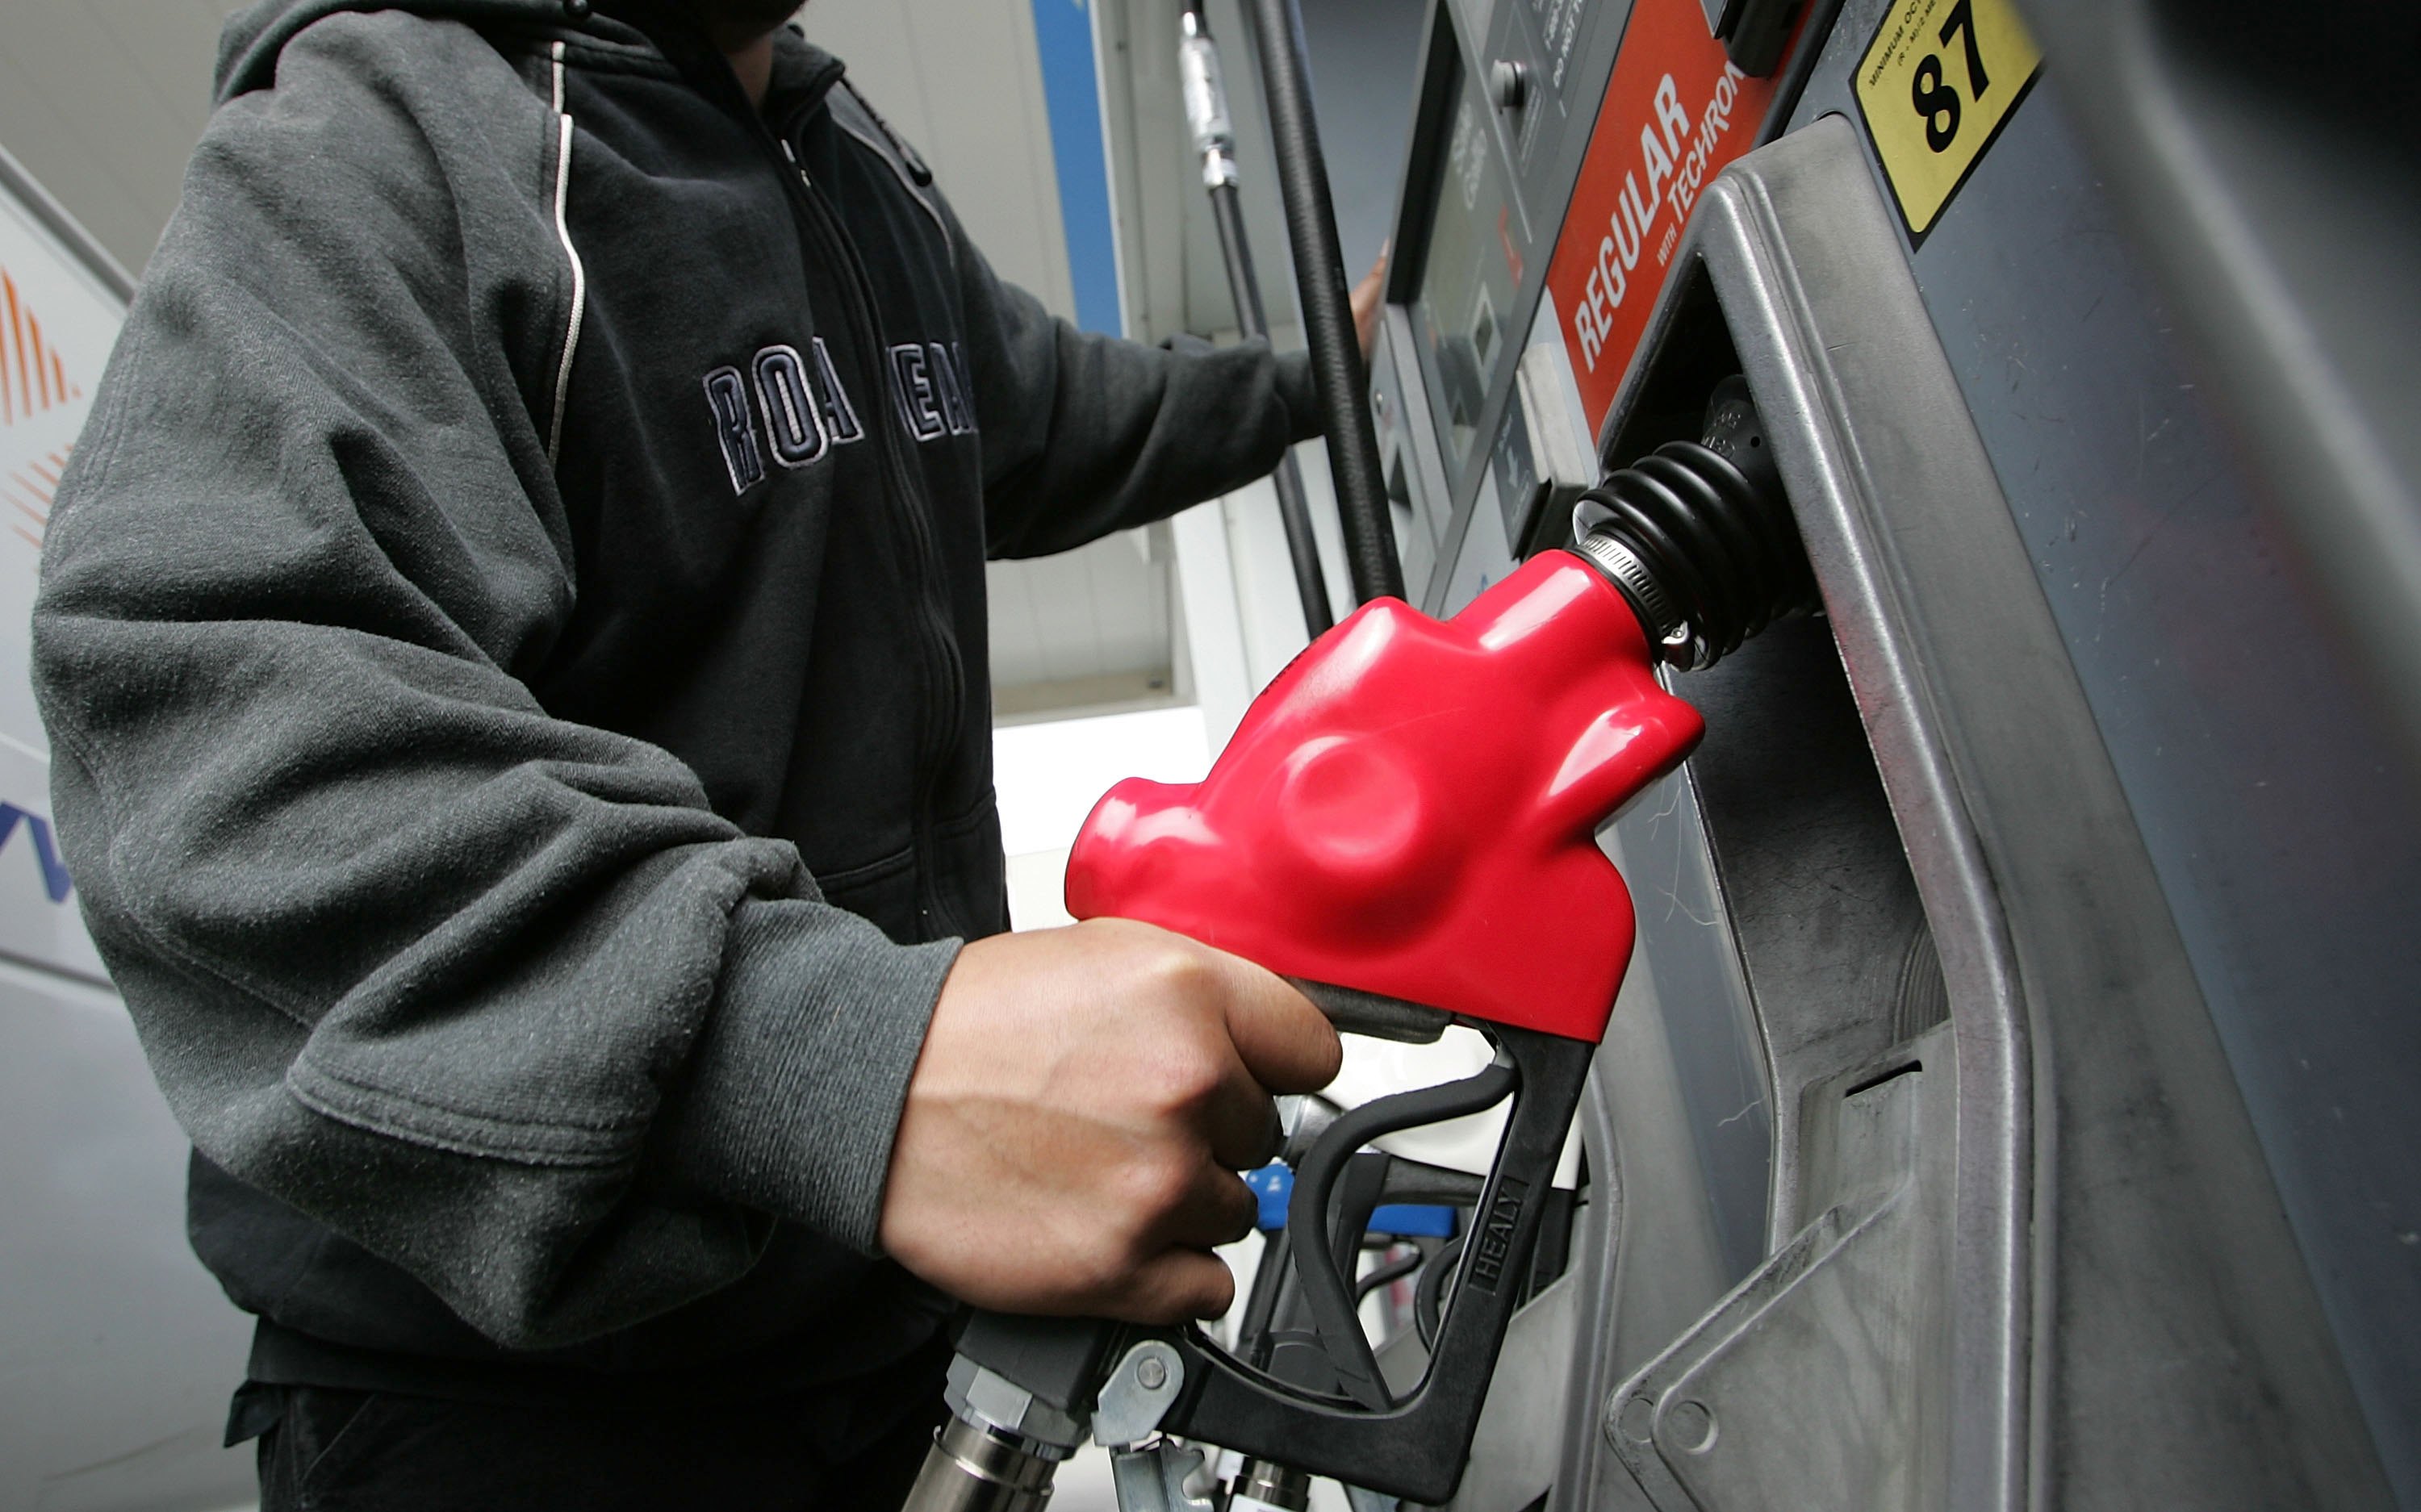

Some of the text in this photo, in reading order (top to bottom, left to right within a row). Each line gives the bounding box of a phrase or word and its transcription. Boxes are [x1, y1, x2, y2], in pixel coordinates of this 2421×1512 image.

[1868, 0, 1921, 87] MINIMUM OC
[1912, 0, 1990, 154] 87
[1574, 73, 1691, 374] REGULAR
[1656, 60, 1746, 268] WITH TECHRON
[1475, 1185, 1523, 1280] HEALY
